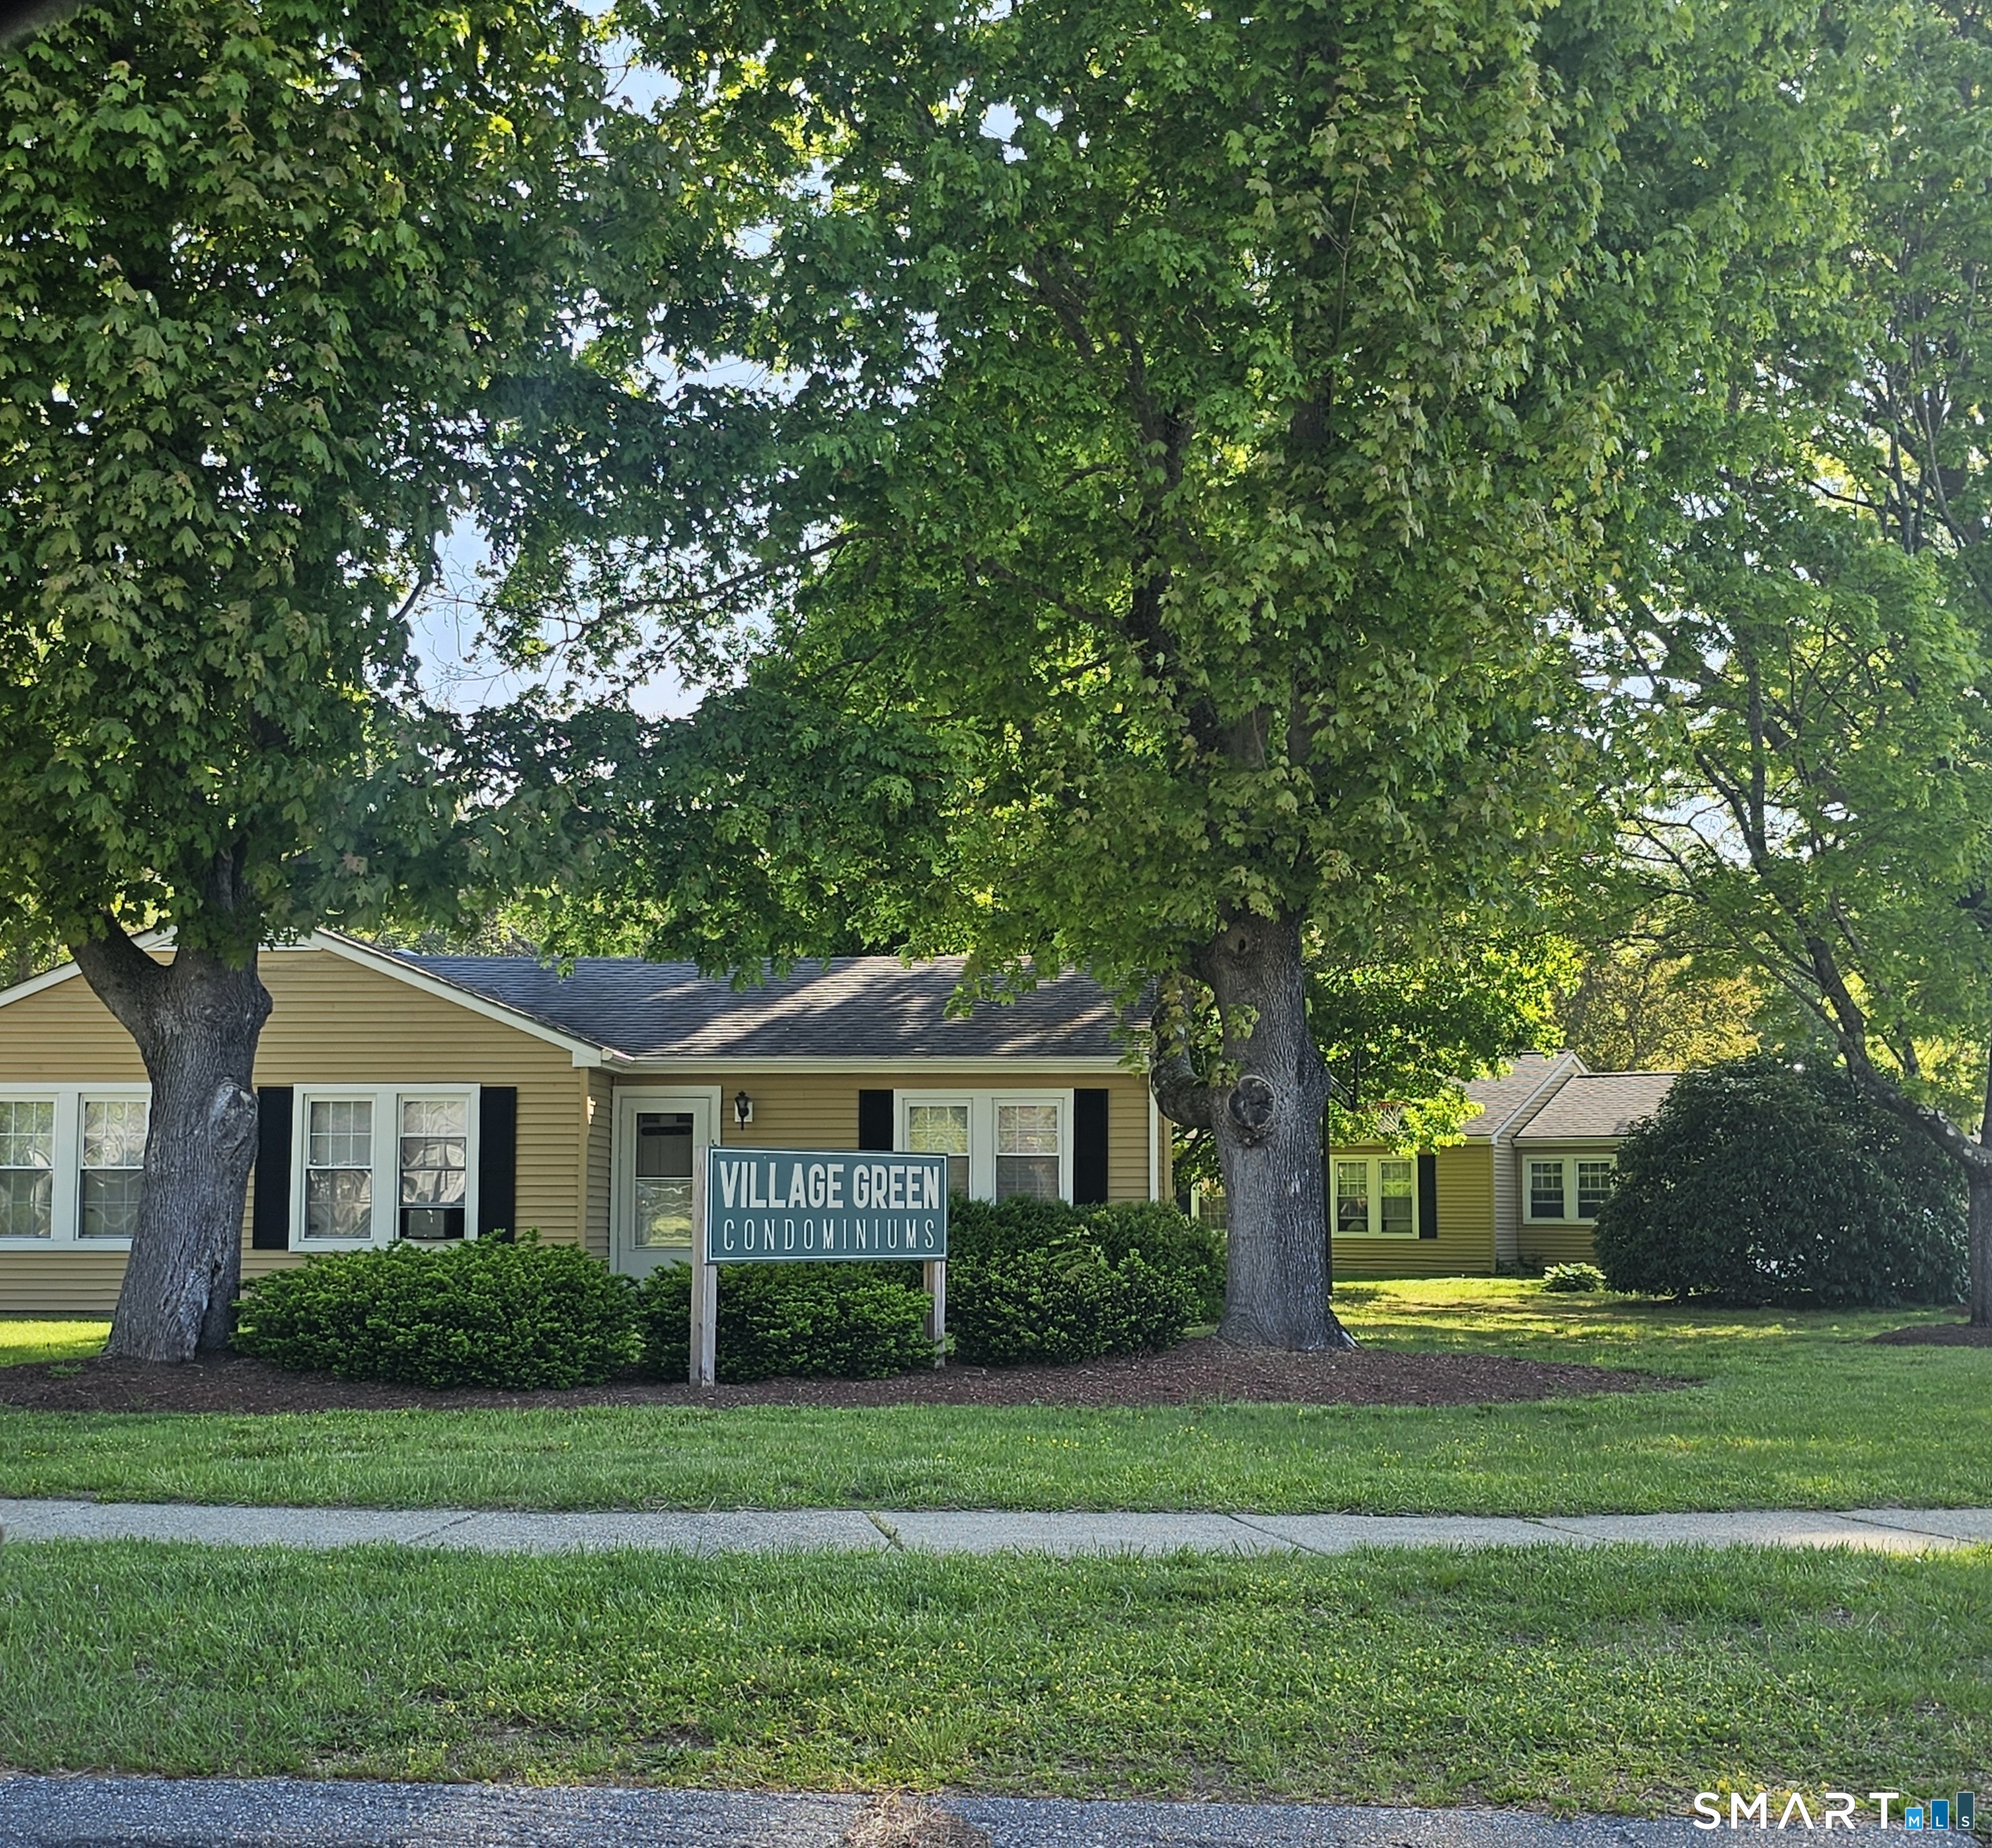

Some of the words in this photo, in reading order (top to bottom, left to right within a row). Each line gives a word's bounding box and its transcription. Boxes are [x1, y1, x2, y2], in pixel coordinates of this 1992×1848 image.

[720, 1161, 844, 1209] VILLAGE
[852, 1164, 939, 1210] GREEN
[723, 1218, 934, 1250] CONDOMINIUMS
